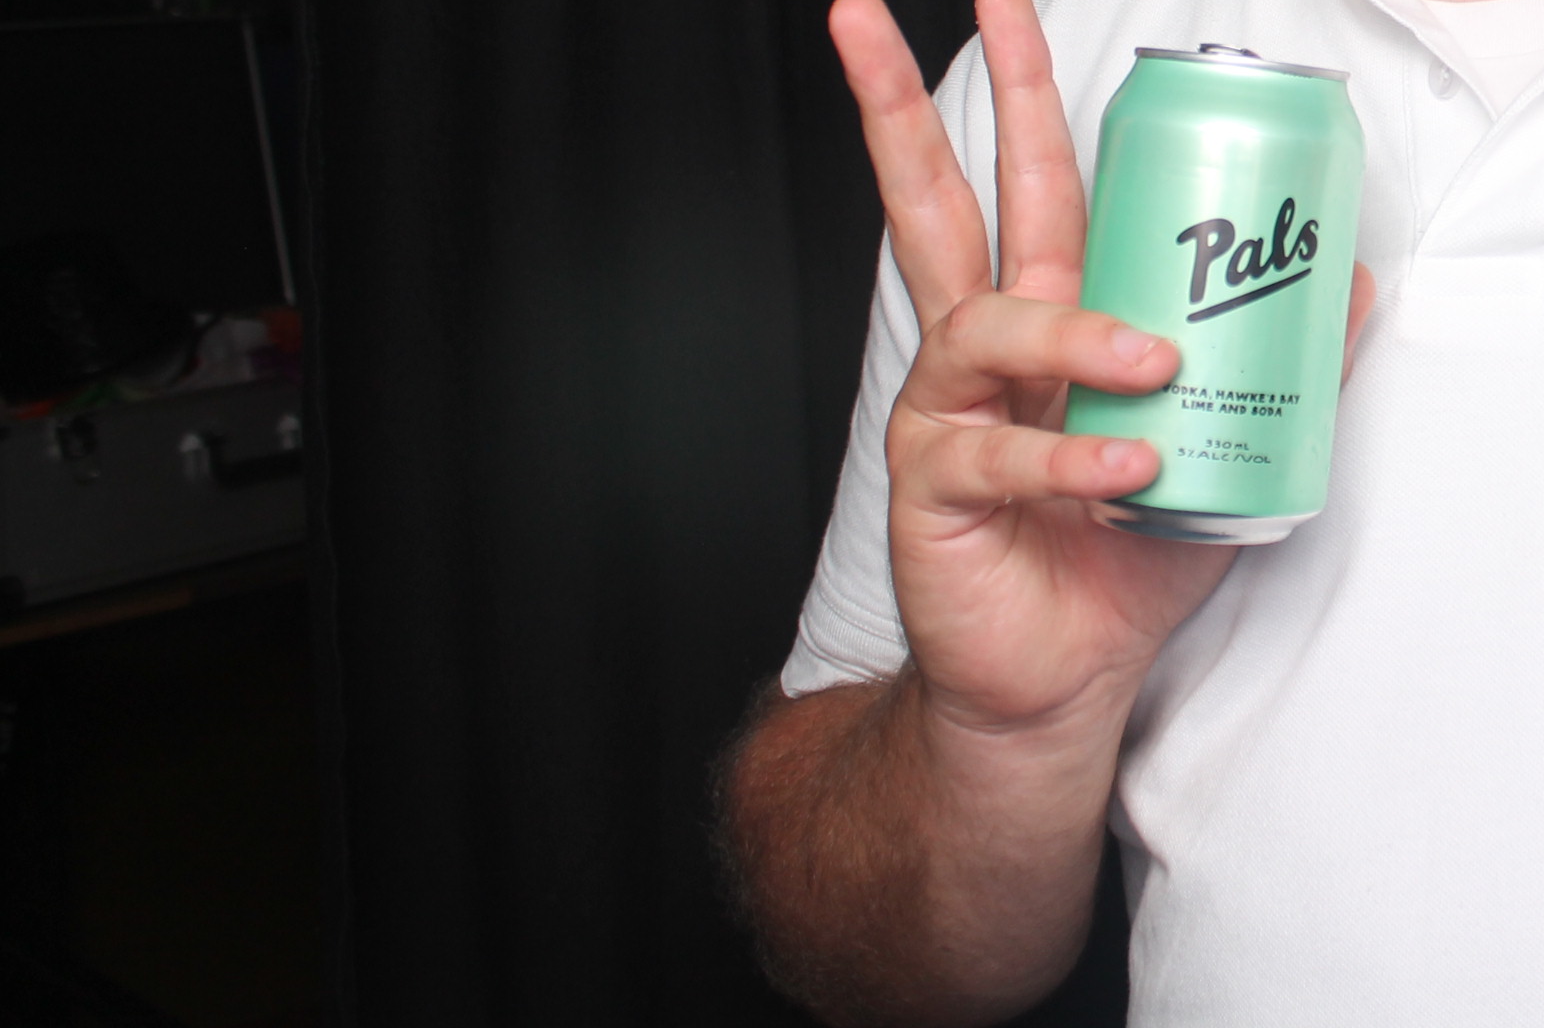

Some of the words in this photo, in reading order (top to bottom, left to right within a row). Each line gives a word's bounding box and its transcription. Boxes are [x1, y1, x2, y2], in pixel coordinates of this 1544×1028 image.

[1175, 197, 1319, 304] Pals
[1215, 390, 1276, 405] HAWKE'S
[1279, 394, 1300, 405] BAY
[1181, 399, 1213, 412] LIME
[1218, 403, 1247, 415] AND
[1251, 407, 1283, 418] SODA
